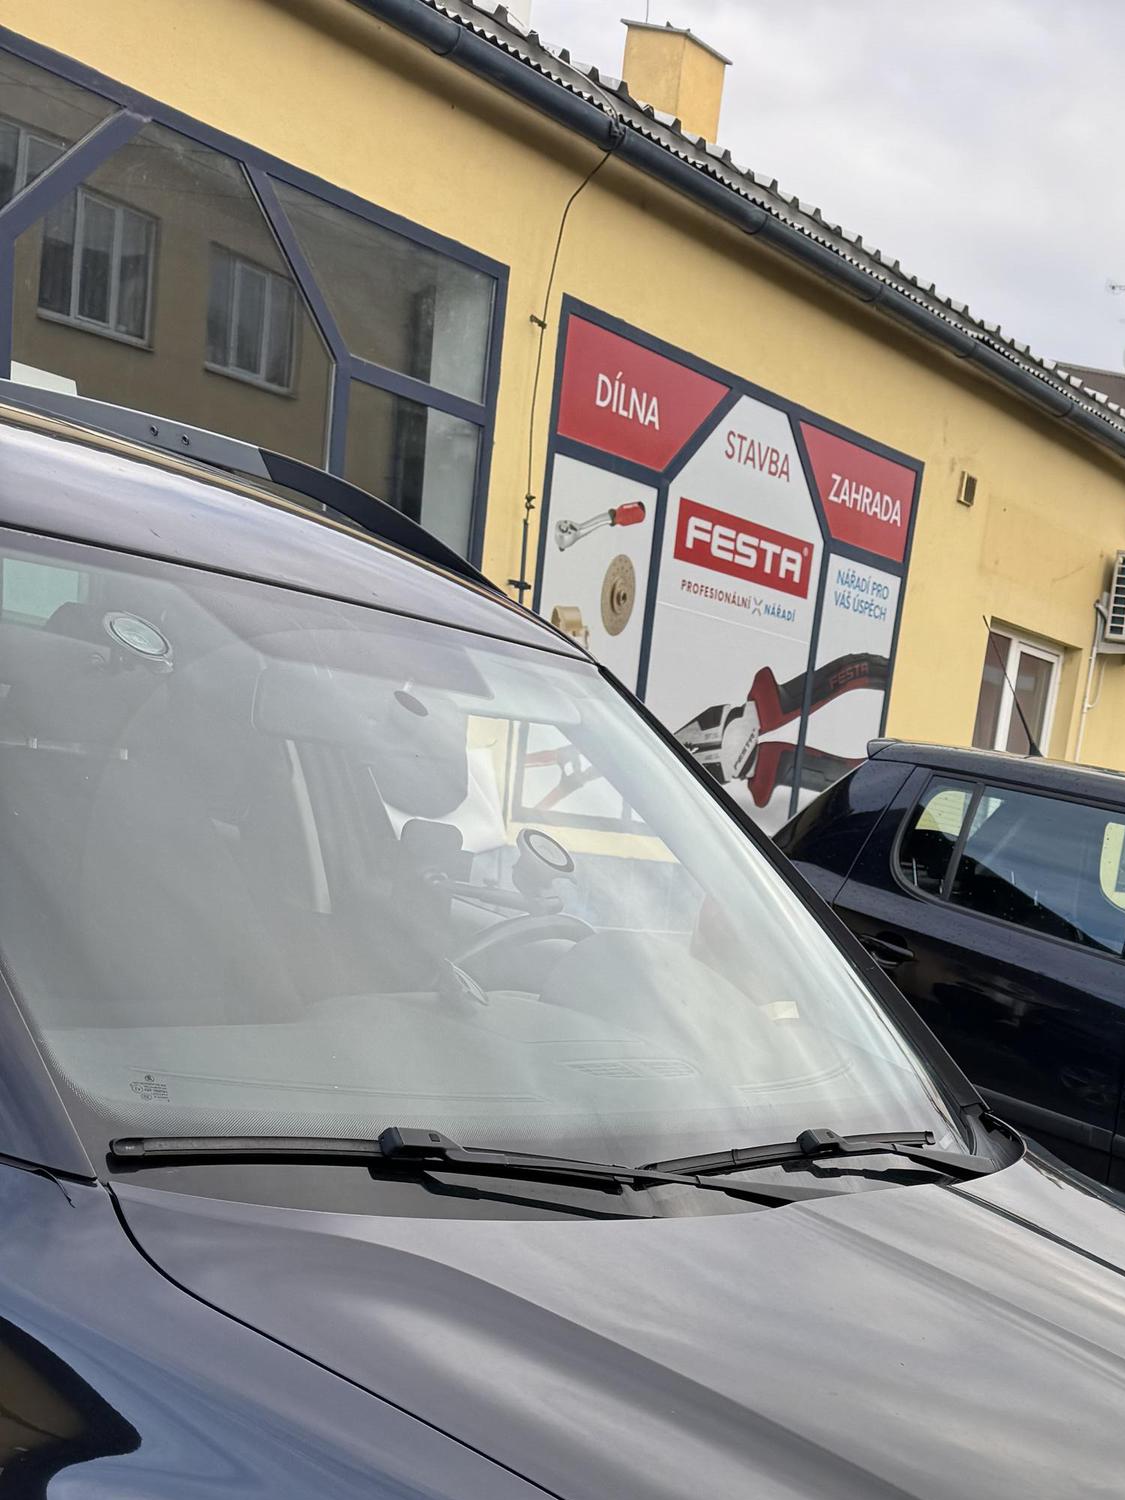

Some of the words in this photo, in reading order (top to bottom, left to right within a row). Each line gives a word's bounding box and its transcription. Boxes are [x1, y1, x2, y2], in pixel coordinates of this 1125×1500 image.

[595, 371, 660, 431] DÍLNA
[724, 430, 790, 482] STAVBA
[828, 472, 901, 527] ZAHRADA
[685, 515, 803, 584] FESTA
[680, 579, 751, 609] PROFESIONÁLNÍ
[763, 603, 796, 622] NÁŘADÍ
[833, 589, 851, 609] VÁŠ
[852, 593, 887, 621] ÚSPĚCH
[836, 568, 871, 594] NÁŘADÍ
[870, 581, 890, 600] PRO
